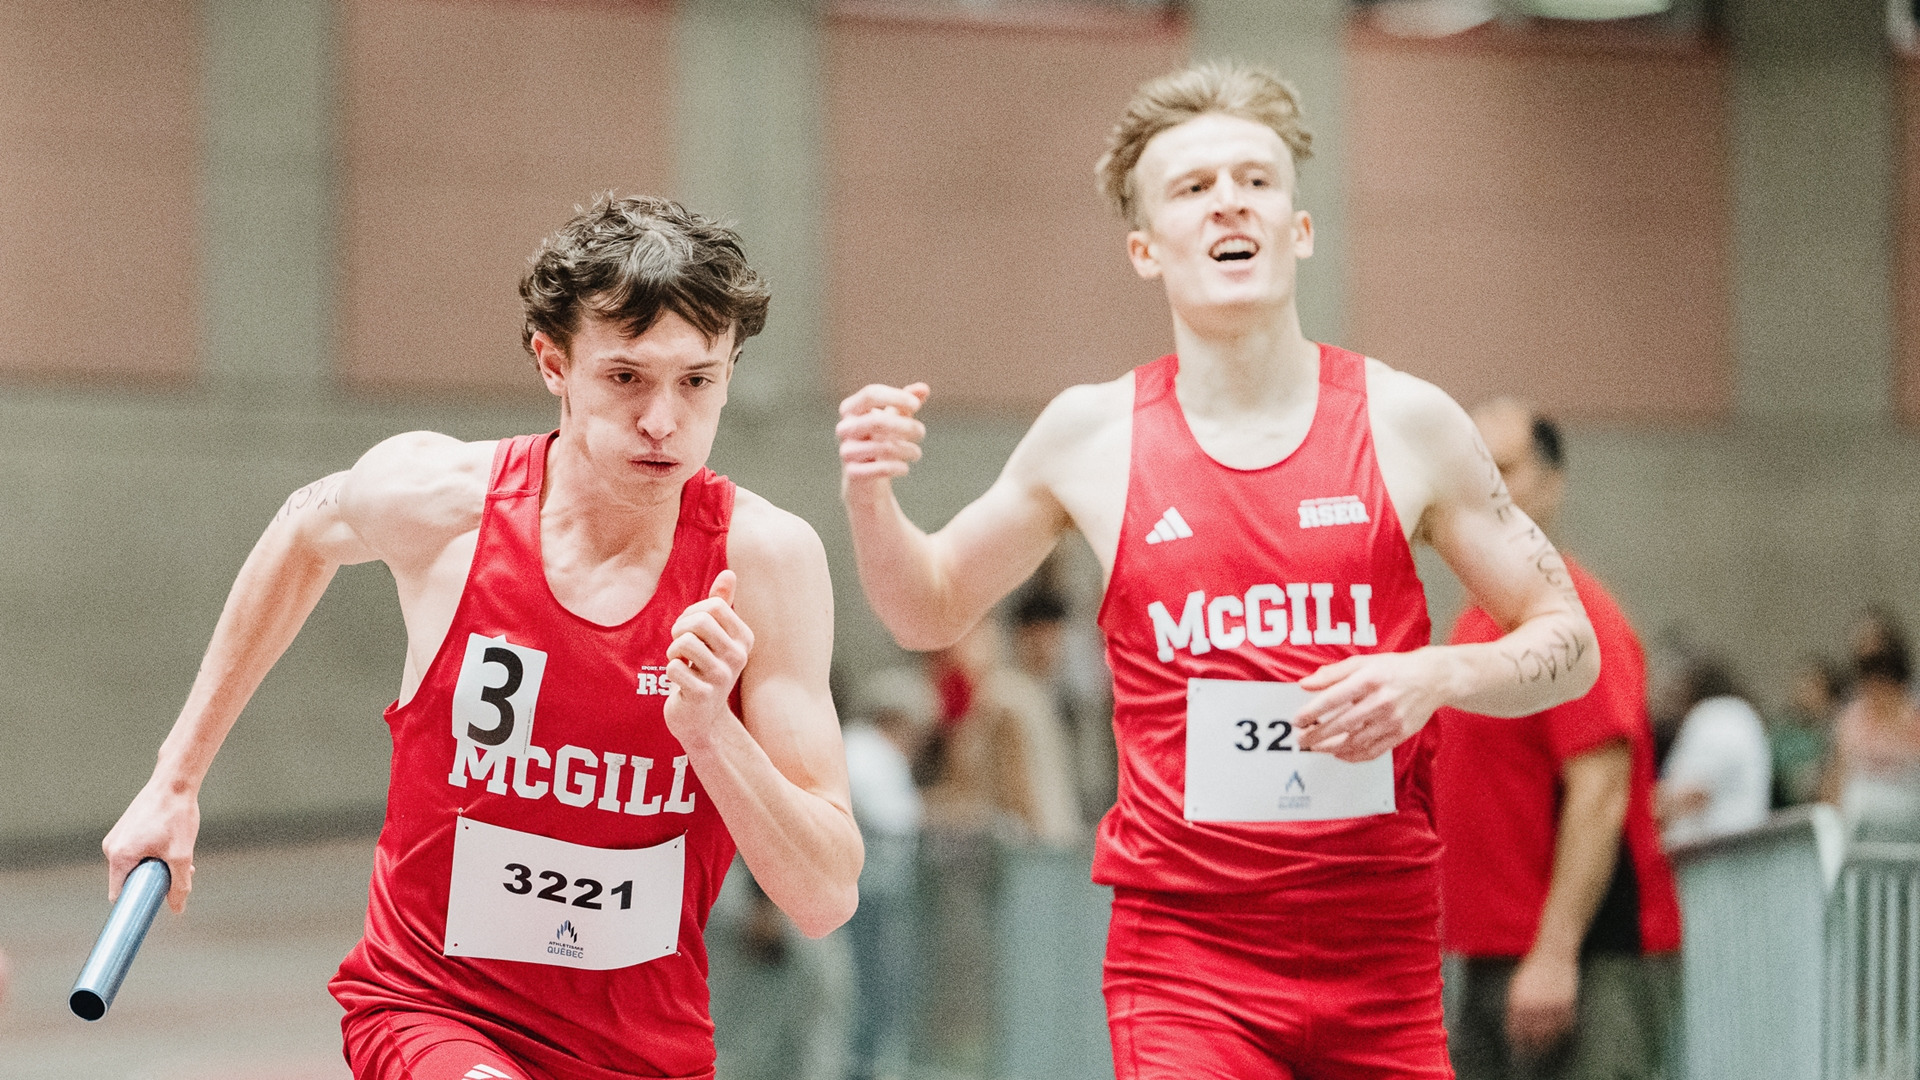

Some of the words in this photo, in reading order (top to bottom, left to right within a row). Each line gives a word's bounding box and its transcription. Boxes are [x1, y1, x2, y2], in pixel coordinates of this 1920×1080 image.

[1148, 583, 1377, 663] McGILL
[466, 647, 524, 746] 3
[636, 673, 671, 696] RS
[1235, 719, 1312, 752] 32
[502, 863, 633, 910] 3221
